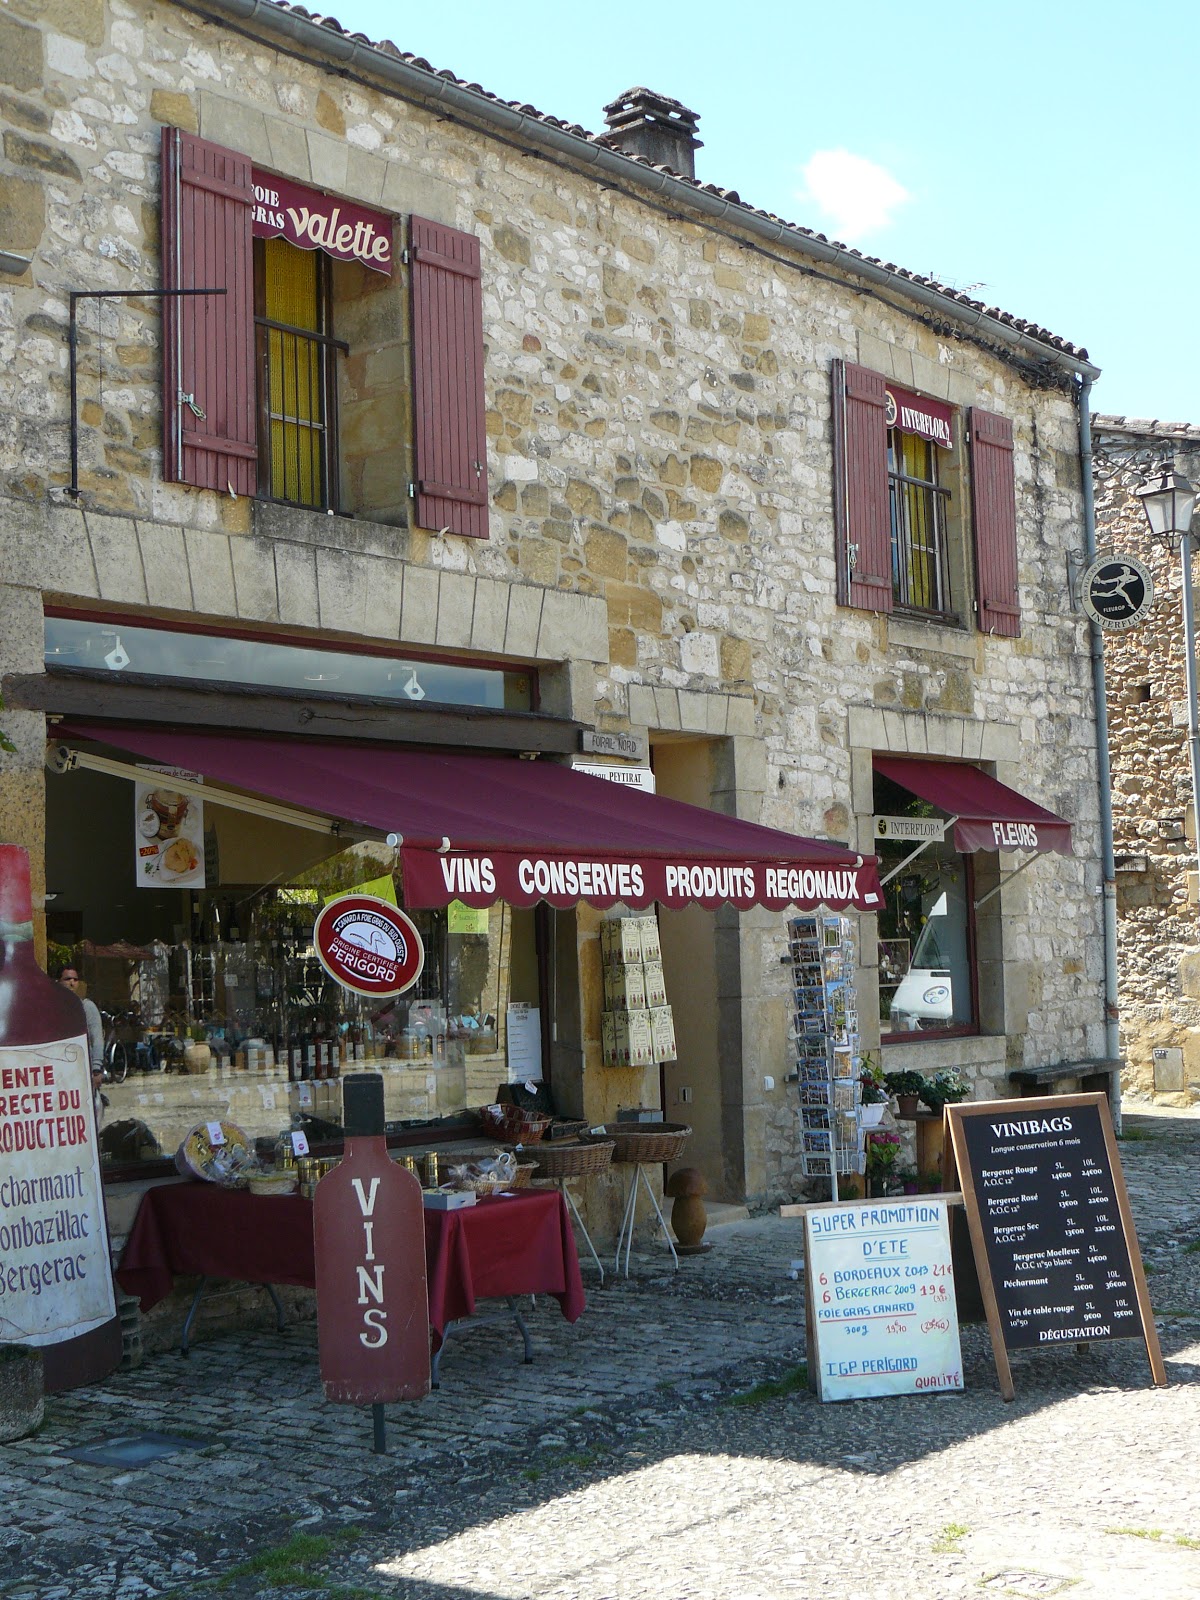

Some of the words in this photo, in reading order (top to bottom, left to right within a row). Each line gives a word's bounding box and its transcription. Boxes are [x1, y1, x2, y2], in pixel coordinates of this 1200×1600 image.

[251, 184, 279, 207] OIE
[901, 406, 950, 441] INTERFLORA
[1103, 605, 1125, 613] FLEUROP
[1091, 603, 1150, 628] INTERFLORA
[618, 740, 637, 753] NORD
[890, 821, 941, 837] INTERFLORA
[992, 822, 1038, 847] FLEURS
[441, 857, 496, 893] VINS
[518, 859, 644, 896] CONSERVES
[665, 865, 755, 899] PRODUITS
[766, 868, 859, 900] REGIONAUX
[338, 914, 356, 928] CANARD
[361, 913, 372, 922] FOIE
[372, 917, 383, 928] GRAS
[382, 923, 391, 932] DU
[388, 928, 398, 941] SUD
[395, 938, 404, 958] OUEST
[333, 937, 361, 956] ORIGINE
[362, 952, 399, 972] CERTIFIÉE
[327, 943, 396, 983] PERIGORD
[59, 1089, 81, 1110] DU
[990, 1116, 1073, 1139] VINIBAGS
[991, 1144, 1015, 1154] Longue
[1016, 1140, 1057, 1151] conservation
[1059, 1138, 1064, 1147] 6
[1065, 1138, 1081, 1146] mois
[1055, 1162, 1064, 1170] 5L
[1082, 1159, 1095, 1167] 10L
[982, 1168, 1013, 1179] Bergerac
[1015, 1165, 1038, 1177] Rouge
[1051, 1171, 1072, 1181] 14€00
[1081, 1168, 1102, 1177] 24€00
[1060, 1190, 1069, 1198] 5L
[1089, 1186, 1102, 1195] 10L
[987, 1196, 1019, 1206] Bergerac
[1020, 1193, 1038, 1202] Rosé
[1058, 1199, 1078, 1209] 13€00
[1088, 1196, 1108, 1205] 22€00
[812, 1212, 856, 1234] SUPER
[861, 1206, 939, 1227] PROMOTION
[1066, 1218, 1076, 1226] 5L
[1096, 1215, 1109, 1223] 10L
[993, 1226, 1026, 1235] Bergerac
[1027, 1223, 1039, 1231] Sec
[1065, 1228, 1085, 1236] 13€00
[1094, 1225, 1115, 1233] 22€00
[1013, 1252, 1045, 1261] Bergerac
[1046, 1247, 1080, 1258] Moelleux
[1088, 1245, 1098, 1253] 5L
[351, 1177, 388, 1348] VINS
[1053, 1258, 1073, 1266] blanc
[1086, 1255, 1107, 1264] 14€00
[819, 1273, 828, 1286] 6
[833, 1266, 901, 1284] BORDEAUX
[905, 1265, 929, 1278] 2013
[1075, 1273, 1085, 1281] 5L
[1107, 1270, 1120, 1278] 10L
[1003, 1277, 1049, 1288] Pécharmant
[1073, 1283, 1094, 1292] 21€00
[1105, 1280, 1127, 1289] 36€00
[822, 1290, 831, 1303] 6
[835, 1285, 893, 1301] BERGERAC
[894, 1284, 916, 1295] 2009
[1085, 1302, 1095, 1310] 5L
[1115, 1299, 1128, 1307] 10L
[843, 1304, 871, 1317] GRAS
[873, 1302, 915, 1314] CANARD
[1008, 1309, 1021, 1317] Vin
[1022, 1307, 1031, 1316] de
[1033, 1306, 1052, 1315] table
[1053, 1304, 1075, 1315] rouge
[1113, 1309, 1133, 1318] 15€00
[1083, 1312, 1101, 1321] 9€00
[1039, 1325, 1111, 1341] DÉGUSTATION
[826, 1362, 857, 1377] IGP
[862, 1357, 918, 1374] PERIGORD
